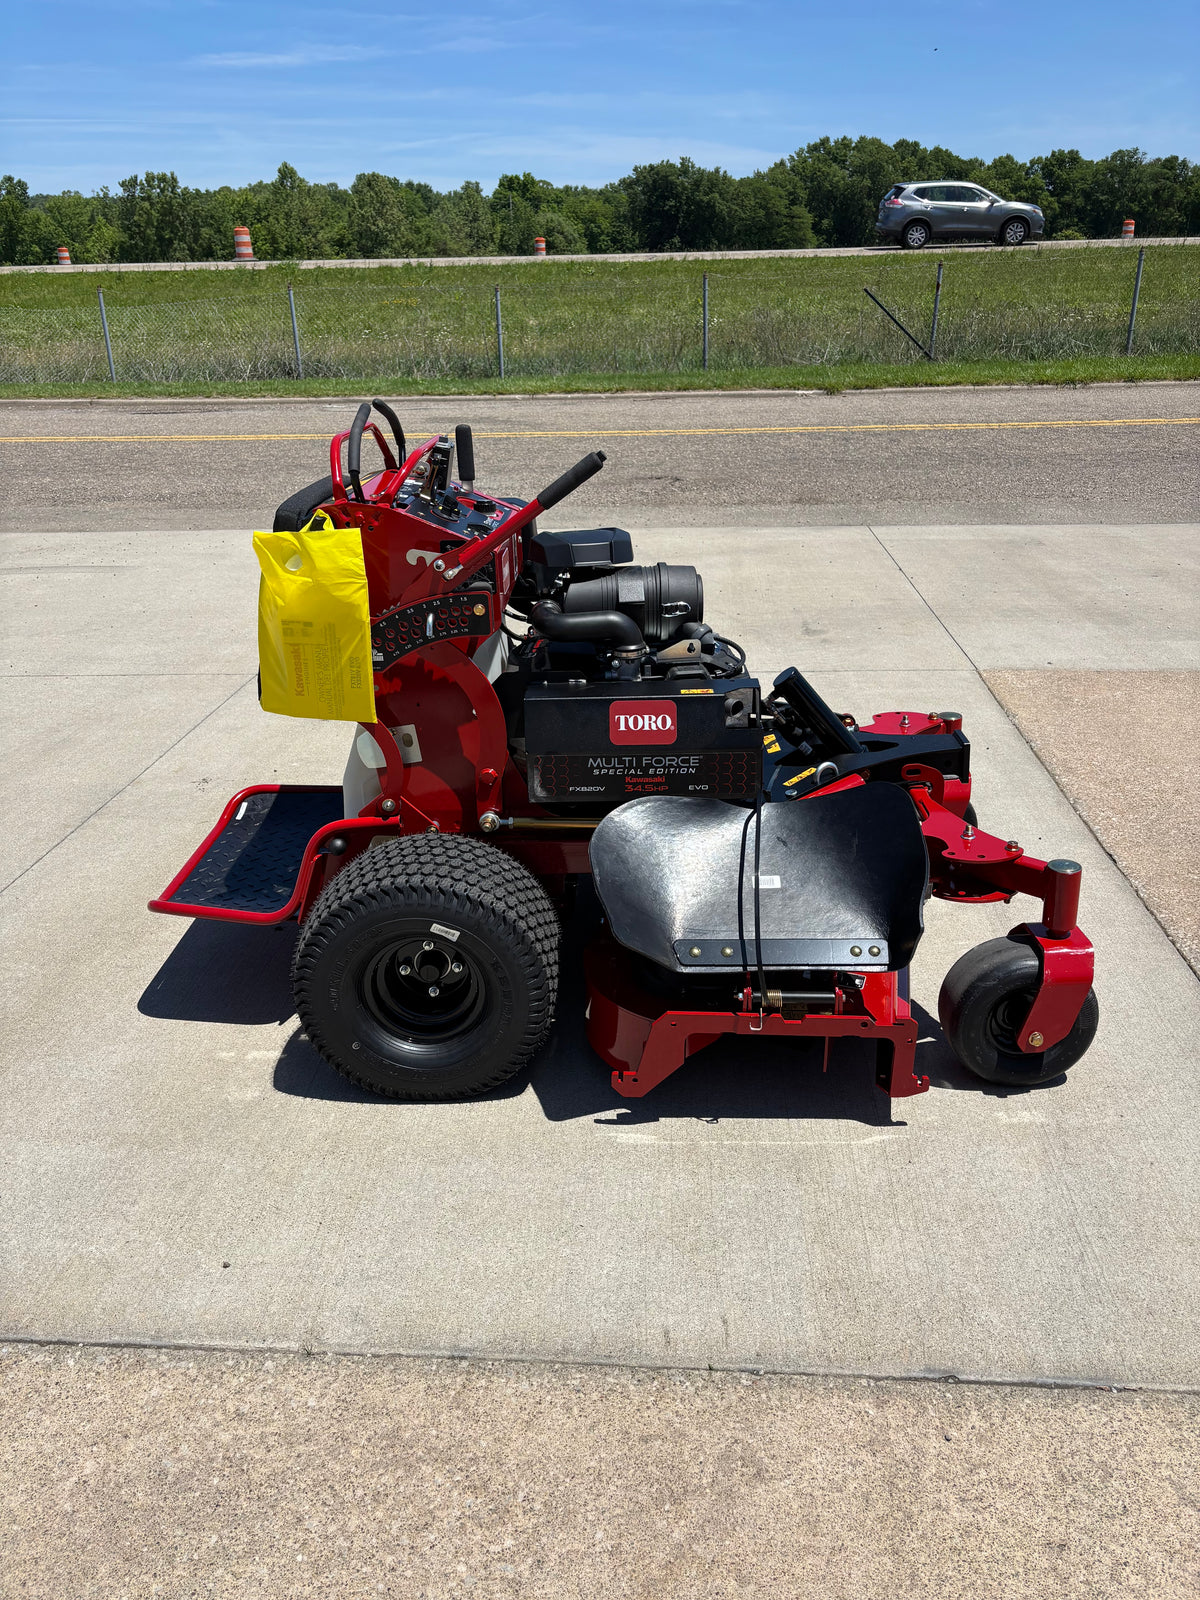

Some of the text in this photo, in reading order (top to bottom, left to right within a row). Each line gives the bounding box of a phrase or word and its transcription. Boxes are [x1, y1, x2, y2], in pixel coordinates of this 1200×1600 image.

[290, 643, 304, 697] Kawasaki
[615, 714, 672, 731] TORO
[588, 756, 699, 768] MULTI FORCE
[625, 784, 668, 792] 34.5HP
